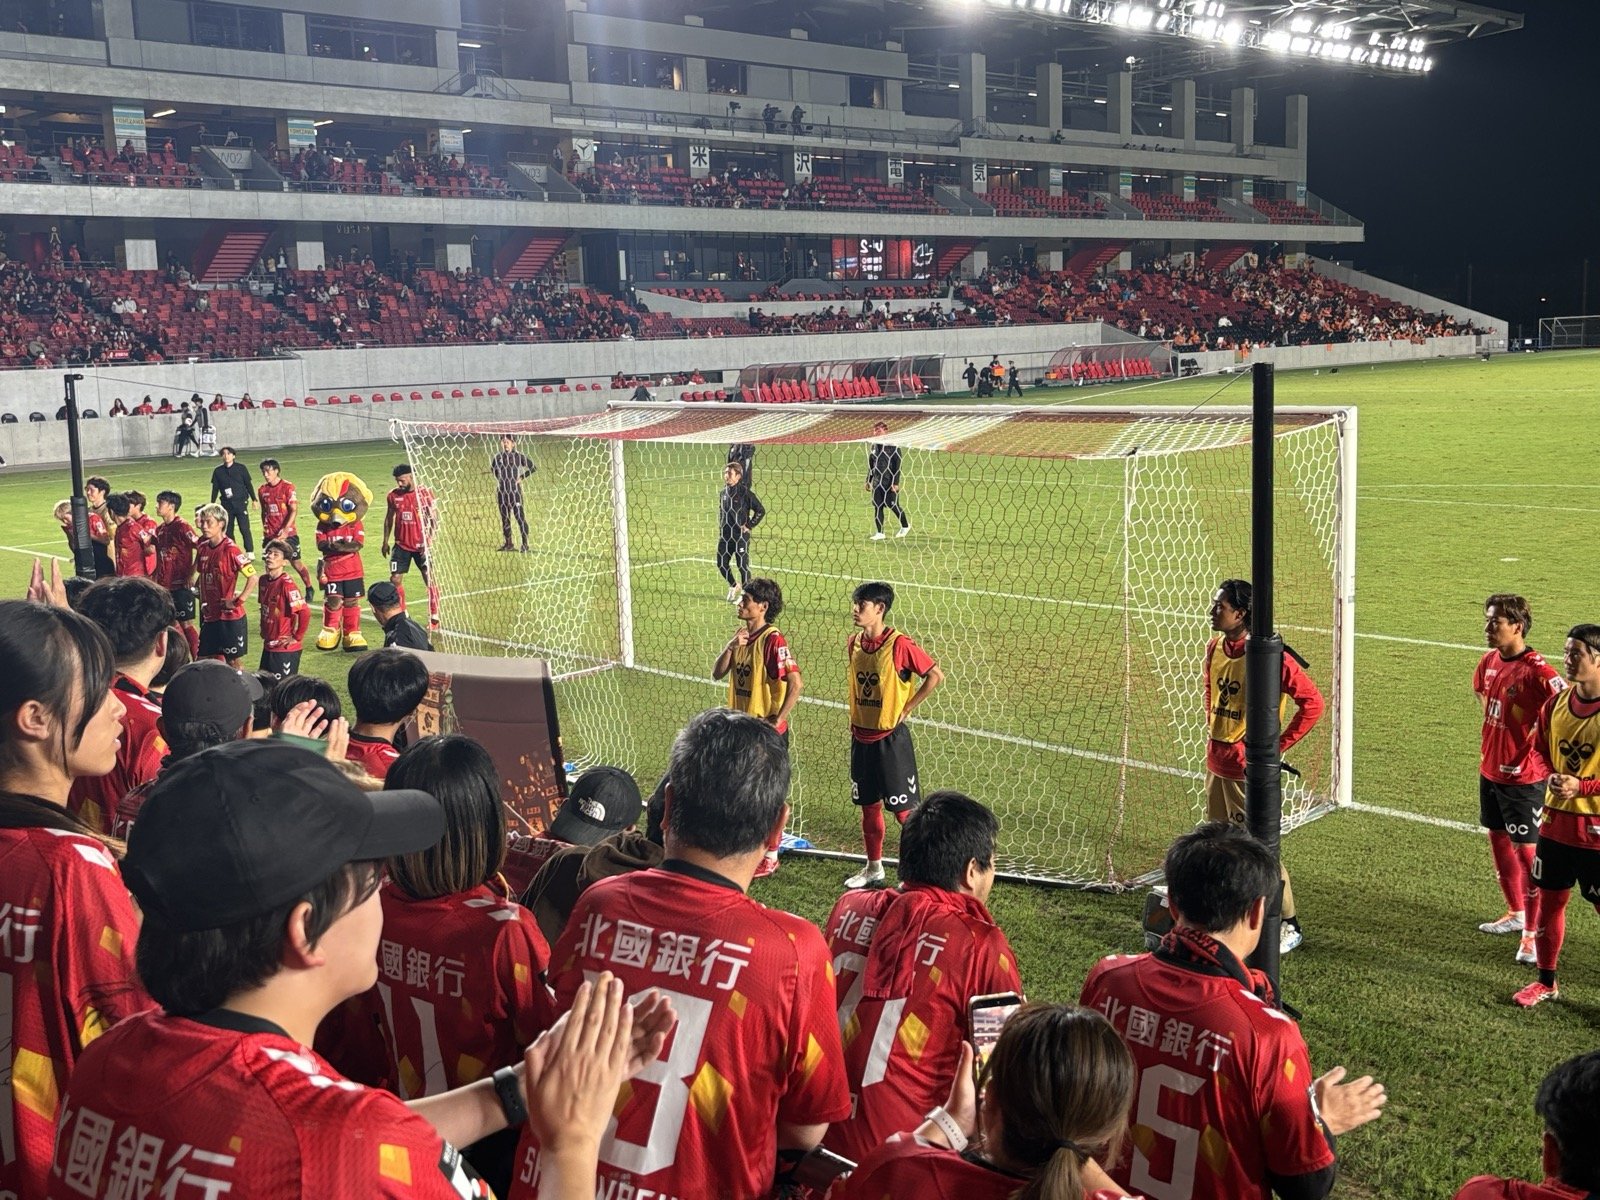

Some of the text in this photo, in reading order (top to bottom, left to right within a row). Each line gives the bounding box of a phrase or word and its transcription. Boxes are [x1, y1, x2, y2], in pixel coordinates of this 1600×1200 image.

[692, 146, 986, 182] 米 沢 電 気
[328, 582, 338, 595] 12
[379, 939, 466, 998] 國銀行
[574, 914, 752, 991] 北國銀行
[1099, 995, 1232, 1072] 北國銀行
[1129, 1063, 1207, 1200] 5
